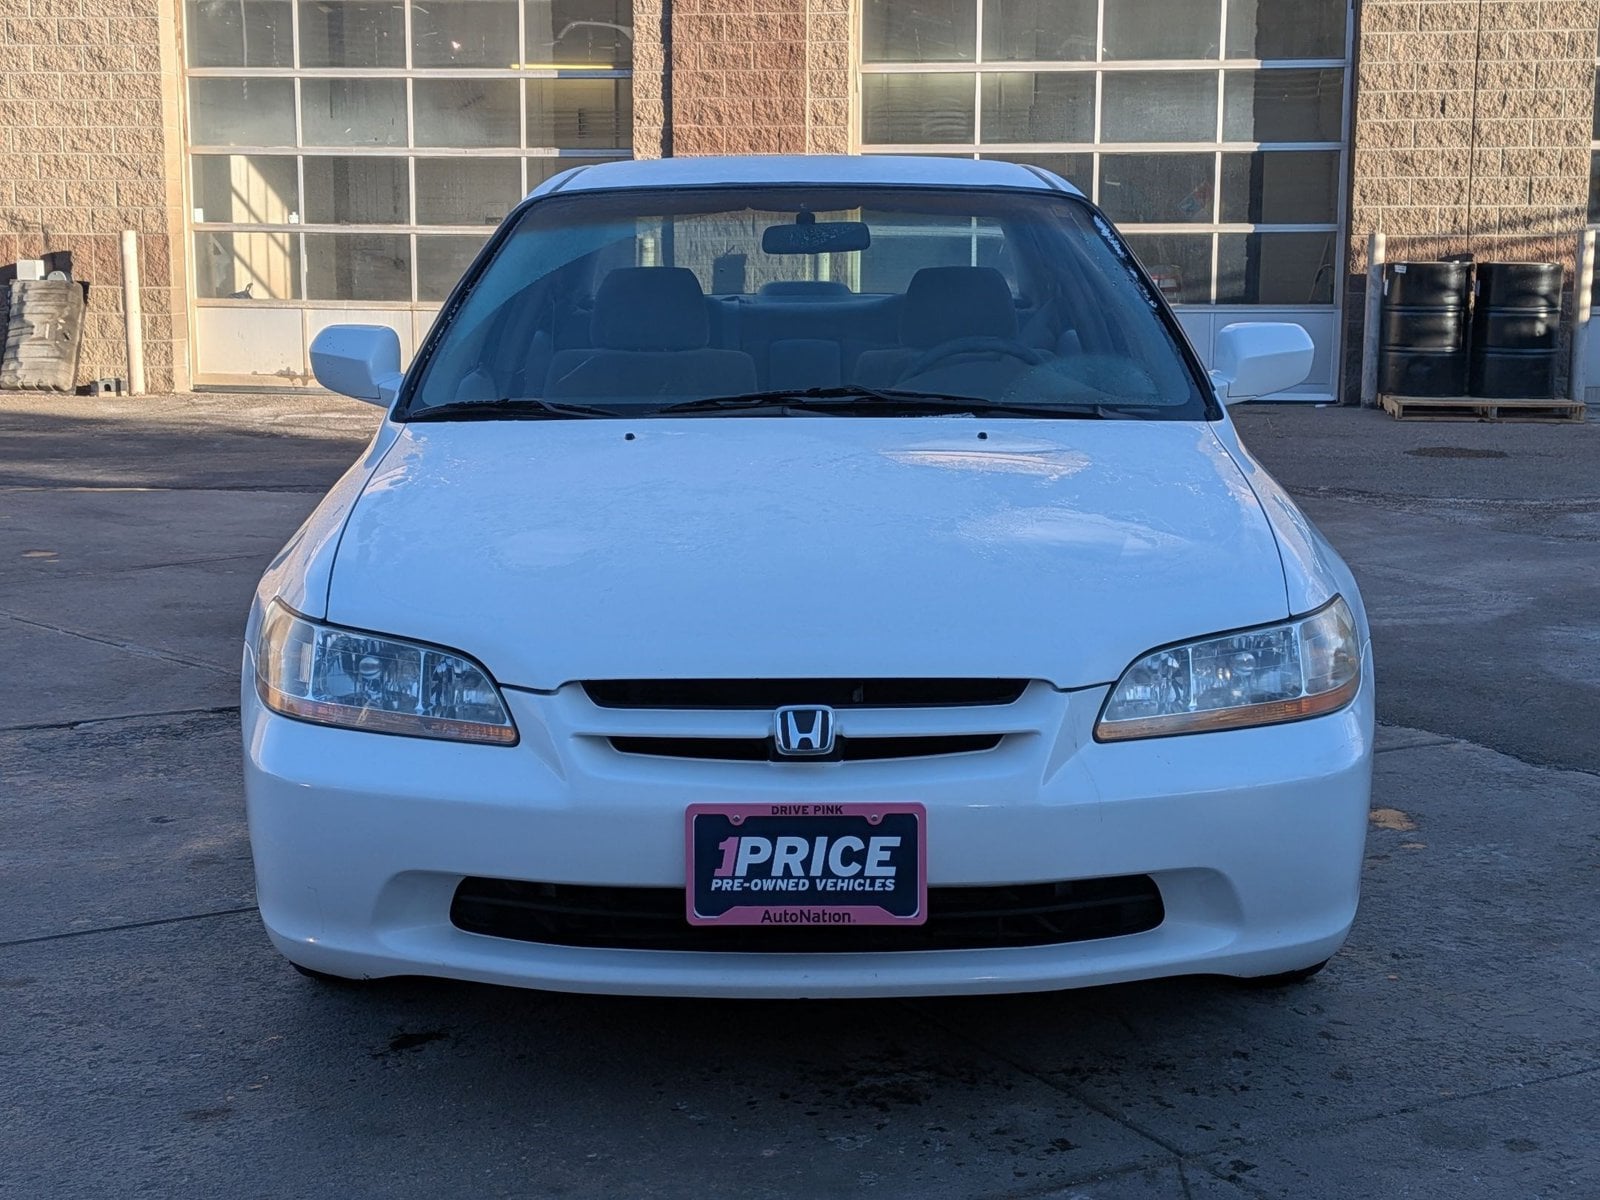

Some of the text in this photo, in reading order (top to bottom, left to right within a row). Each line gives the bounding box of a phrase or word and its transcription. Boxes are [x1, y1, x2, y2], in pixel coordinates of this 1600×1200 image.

[771, 805, 843, 815] DRIVE PINK
[711, 878, 895, 891] PRE-OWNED VEHICLES
